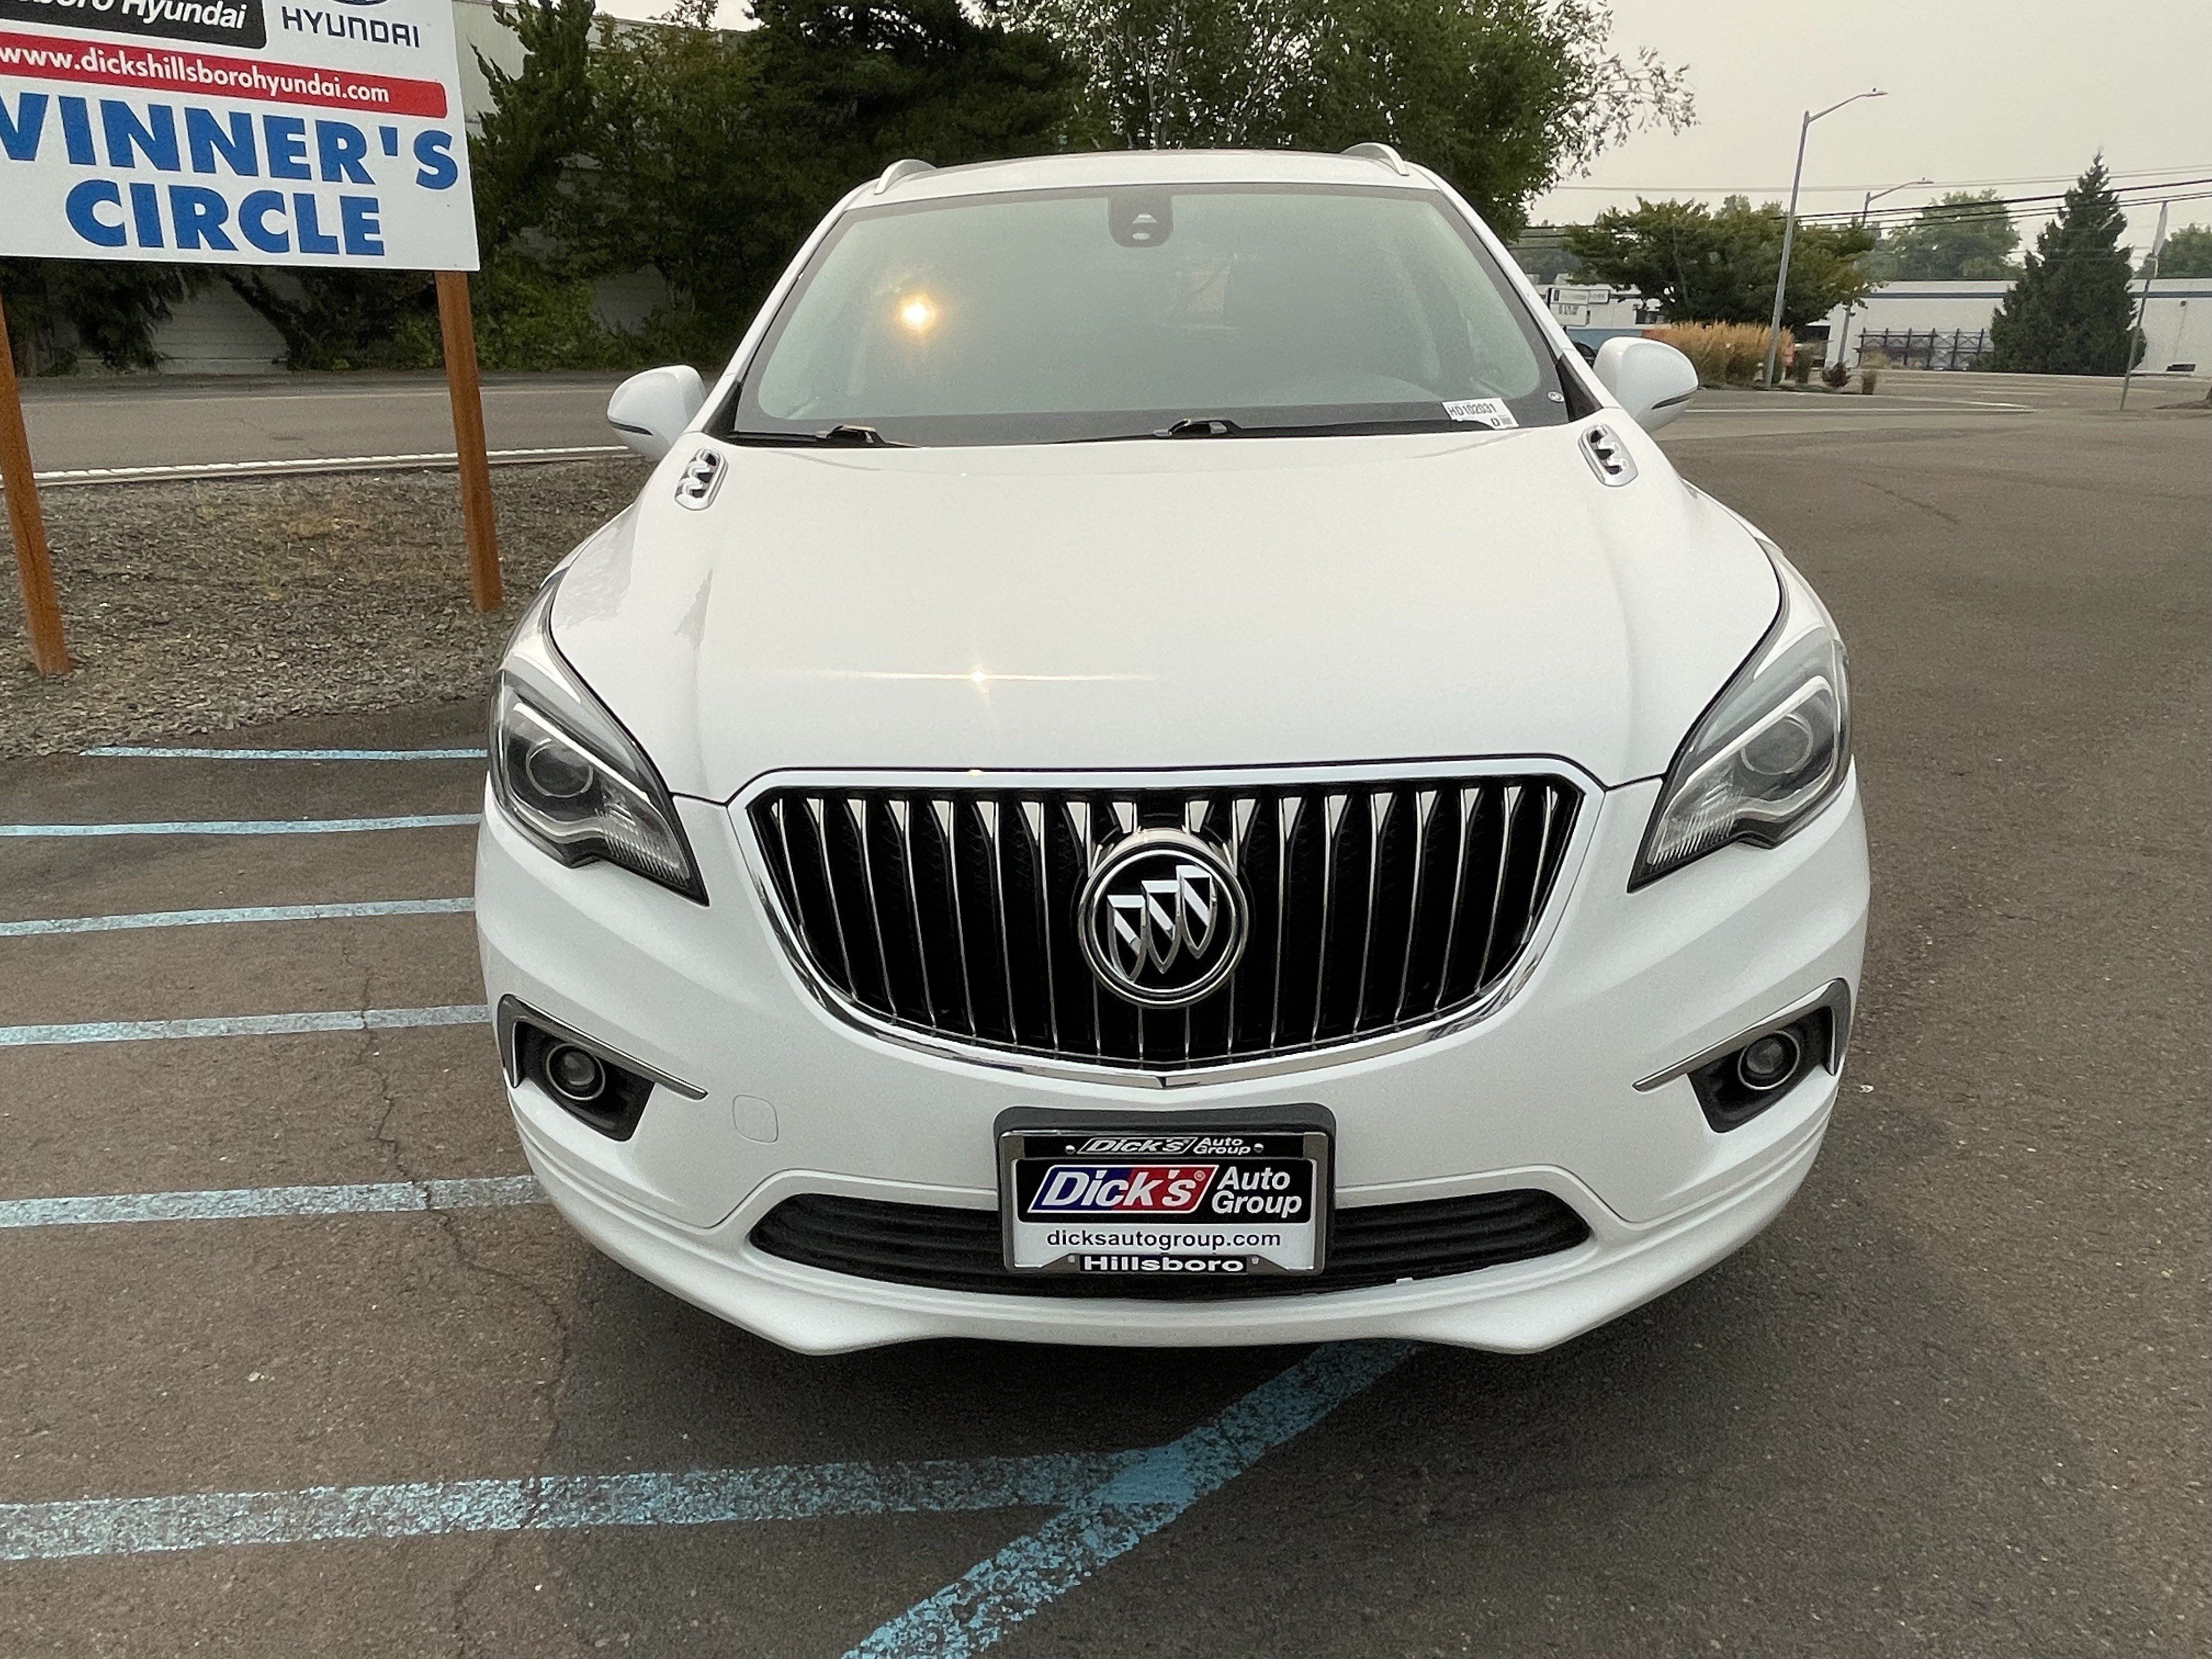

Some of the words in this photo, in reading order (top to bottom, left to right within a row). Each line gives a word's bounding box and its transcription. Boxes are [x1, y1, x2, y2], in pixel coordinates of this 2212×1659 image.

[282, 5, 420, 48] HYUNDAI
[0, 46, 390, 103] www.dickshillsborohyundai.com
[65, 179, 385, 257] CIRCLE
[1086, 1138, 1184, 1152] Dick's
[1193, 1146, 1251, 1155] Group
[1199, 1137, 1244, 1146] Auto
[1042, 1170, 1197, 1207] Dick's
[1217, 1166, 1291, 1190] Auto
[1211, 1190, 1302, 1218] Group
[1047, 1230, 1281, 1251] dicksautogroup.com
[1084, 1256, 1244, 1272] Hillsboro
